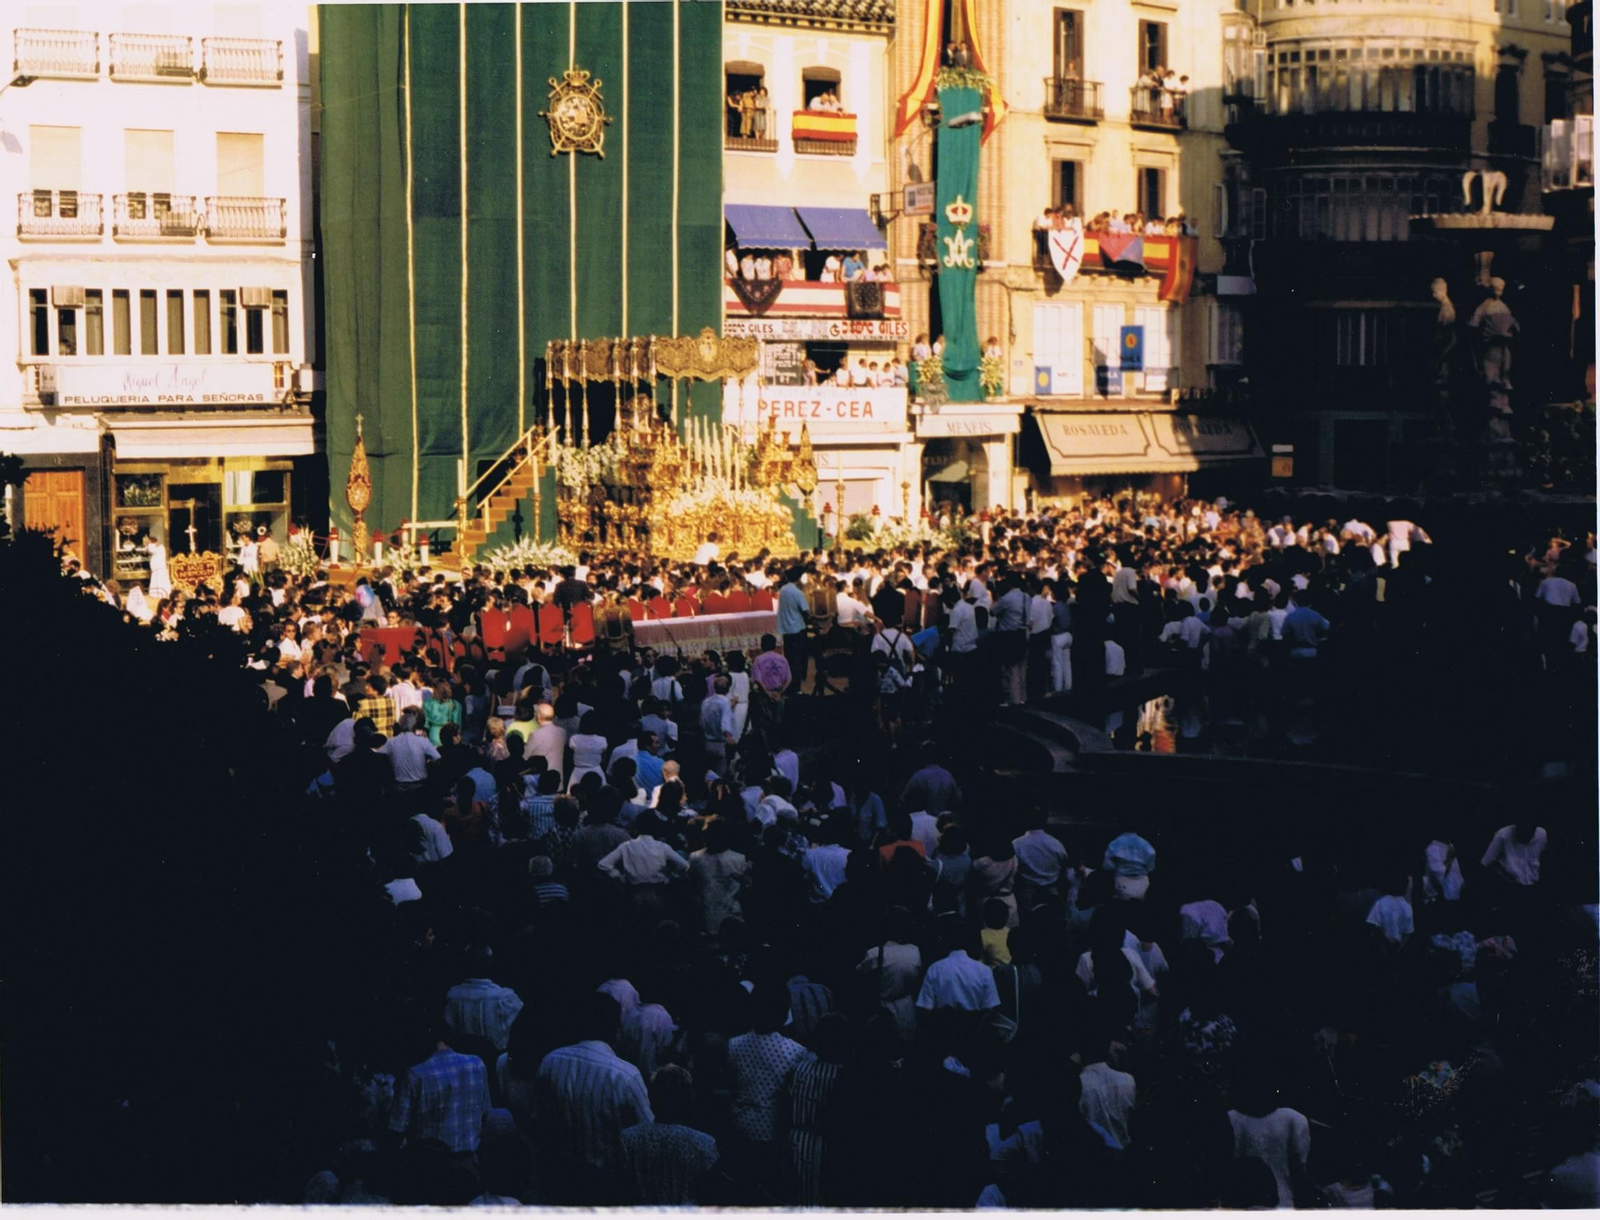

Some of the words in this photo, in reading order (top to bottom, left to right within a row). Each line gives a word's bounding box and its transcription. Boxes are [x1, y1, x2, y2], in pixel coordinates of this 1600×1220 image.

[748, 323, 774, 333] GILES
[879, 321, 908, 336] GILES
[64, 395, 150, 404] PELUQUERIA
[158, 394, 194, 403] PARA
[202, 392, 264, 402] SEÑORAS
[1062, 424, 1130, 437] ROSALEDA
